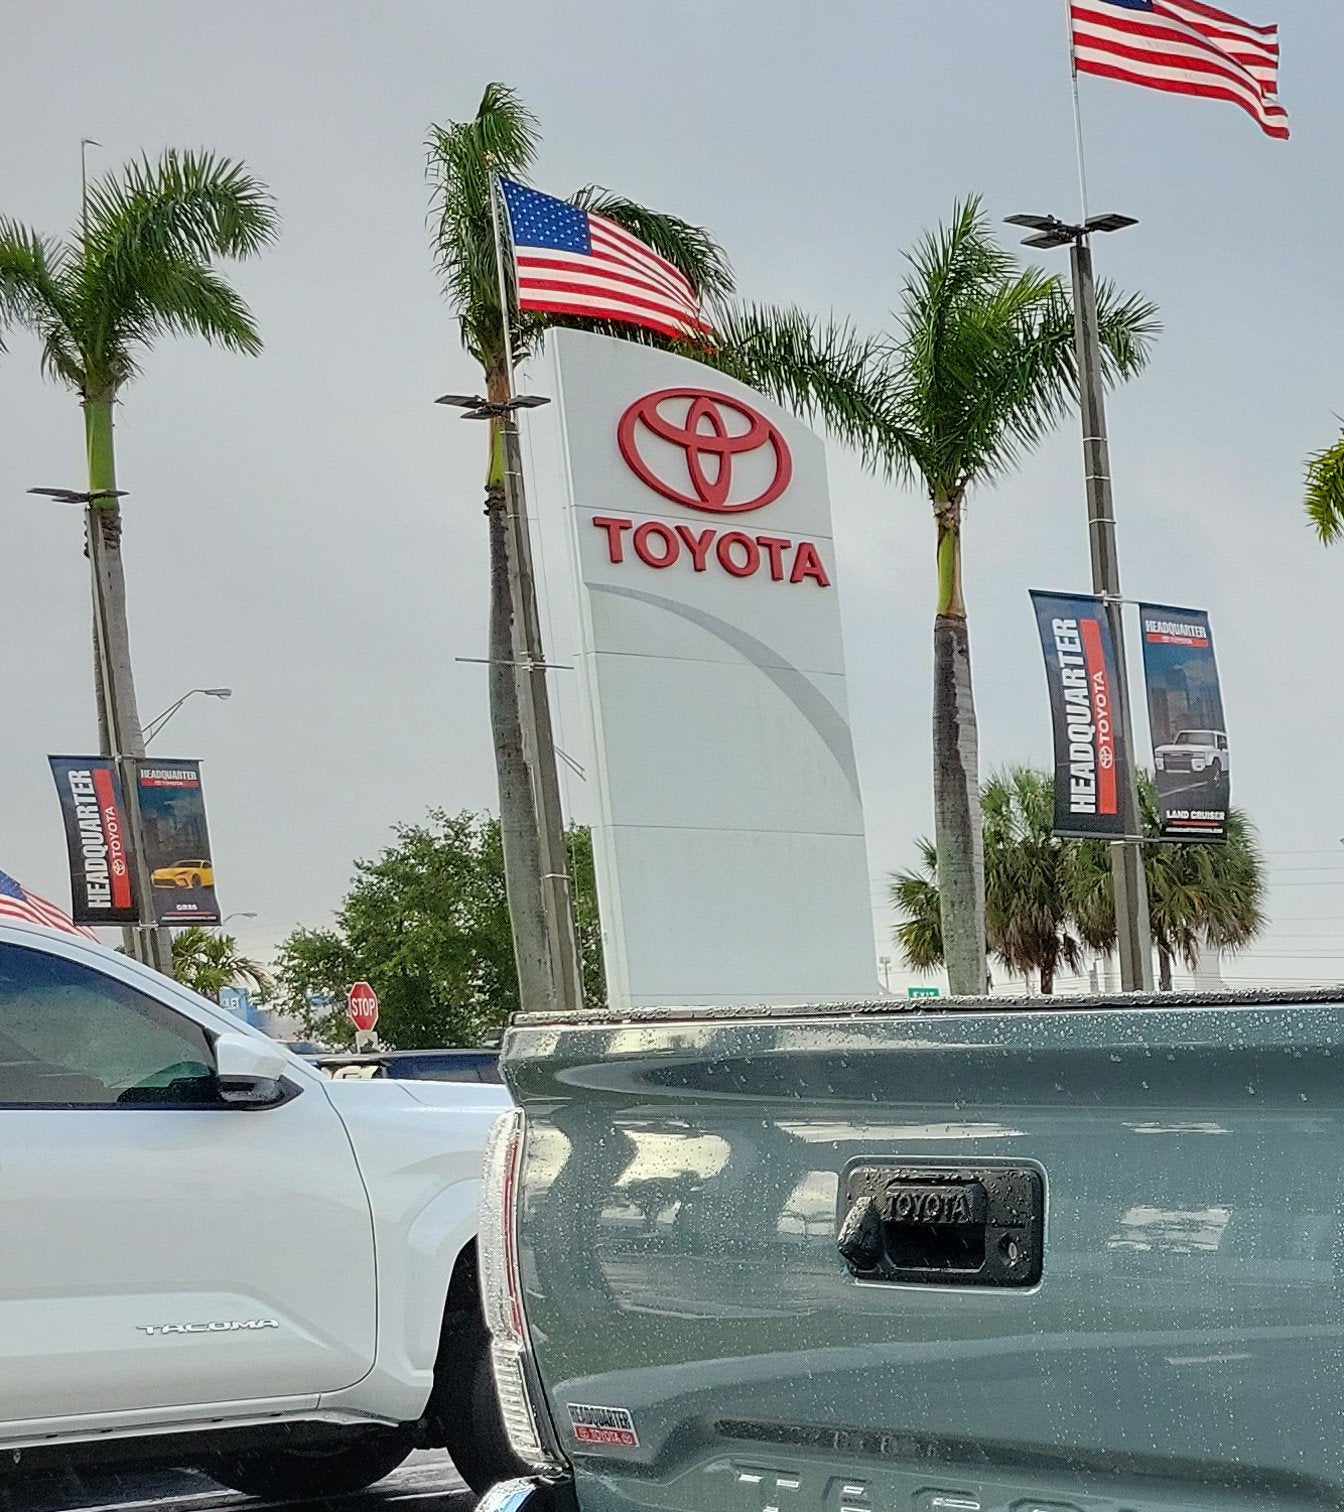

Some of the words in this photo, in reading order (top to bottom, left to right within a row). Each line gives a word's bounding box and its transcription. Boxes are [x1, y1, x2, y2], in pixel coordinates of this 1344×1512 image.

[593, 516, 830, 587] TOYOTA
[1145, 620, 1207, 638] HEADQUARTER
[1052, 618, 1096, 814] HEADQUARTER
[1092, 671, 1113, 743] TOYOTA
[140, 769, 197, 781] HEADQUARTER
[1166, 810, 1189, 819] LAND
[1190, 810, 1225, 820] CRUISER
[68, 770, 112, 908] HEADQUARTER
[105, 806, 122, 858] TOYOTA
[351, 998, 376, 1017] STOP
[881, 1191, 974, 1223] TOYOTA
[136, 1318, 280, 1335] TACOMA
